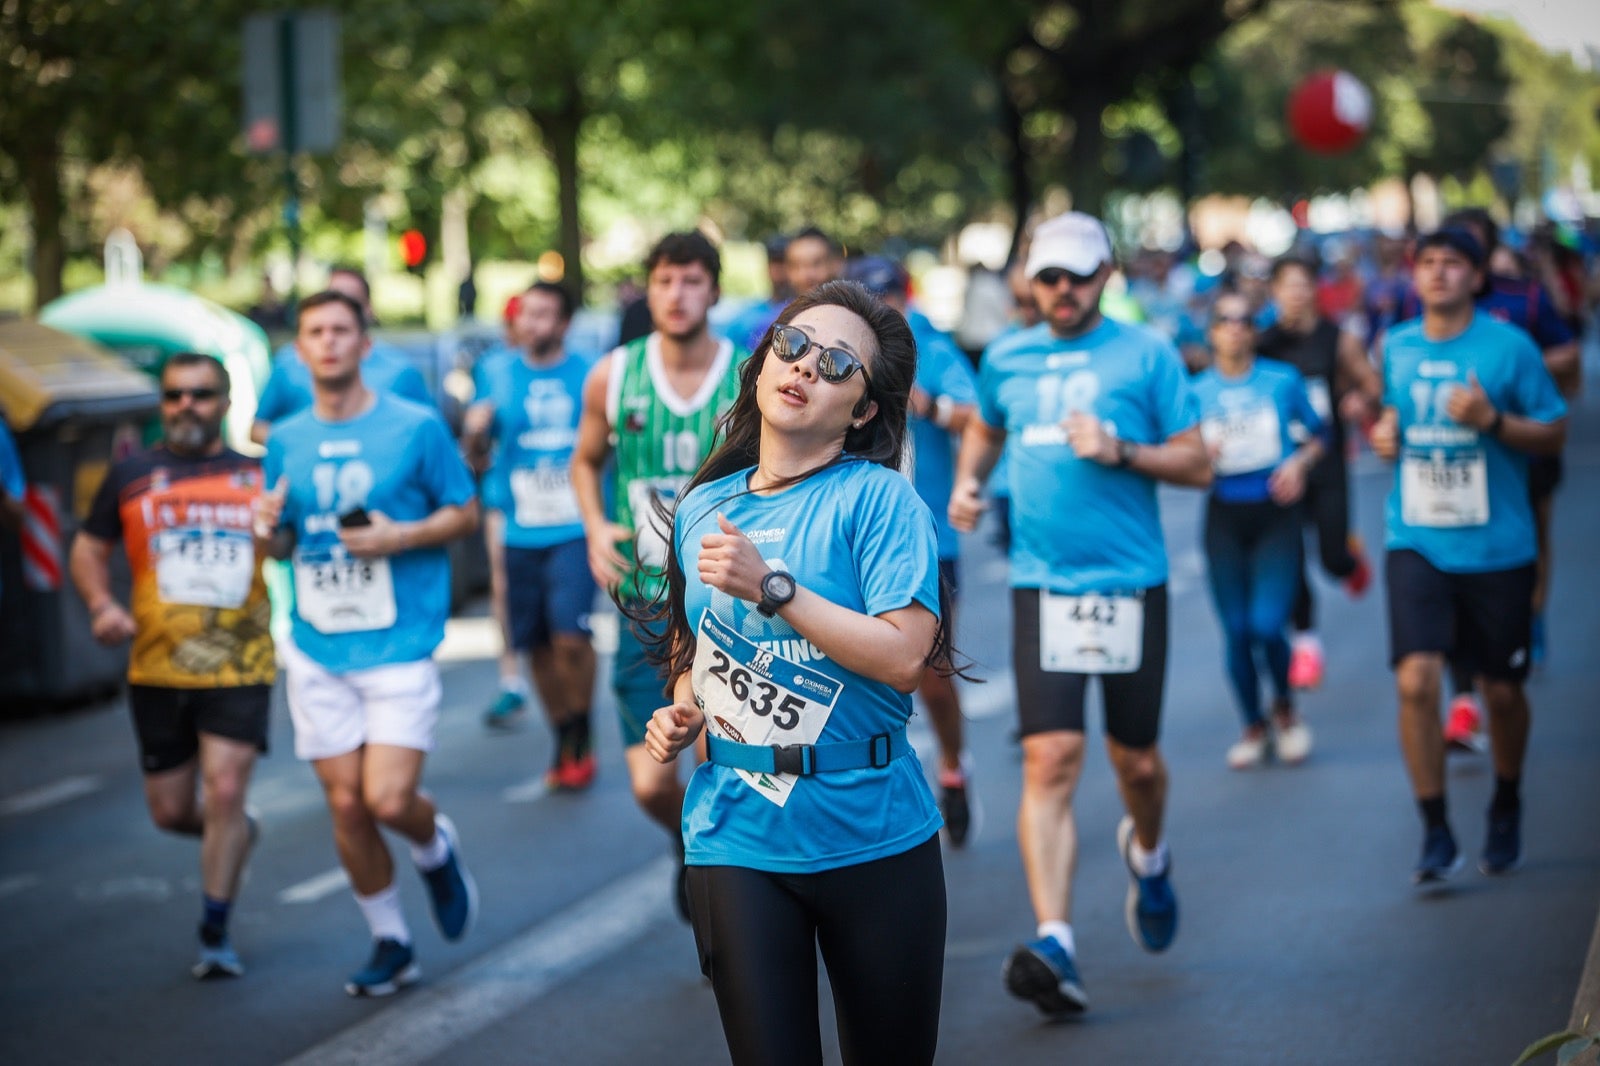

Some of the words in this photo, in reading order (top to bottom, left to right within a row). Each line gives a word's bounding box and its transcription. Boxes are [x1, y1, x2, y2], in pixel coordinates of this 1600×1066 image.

[663, 430, 699, 473] 10
[746, 527, 786, 539] OXIMESA
[1067, 597, 1117, 625] 442
[708, 650, 807, 731] 2635
[804, 678, 832, 694] OXIMESA
